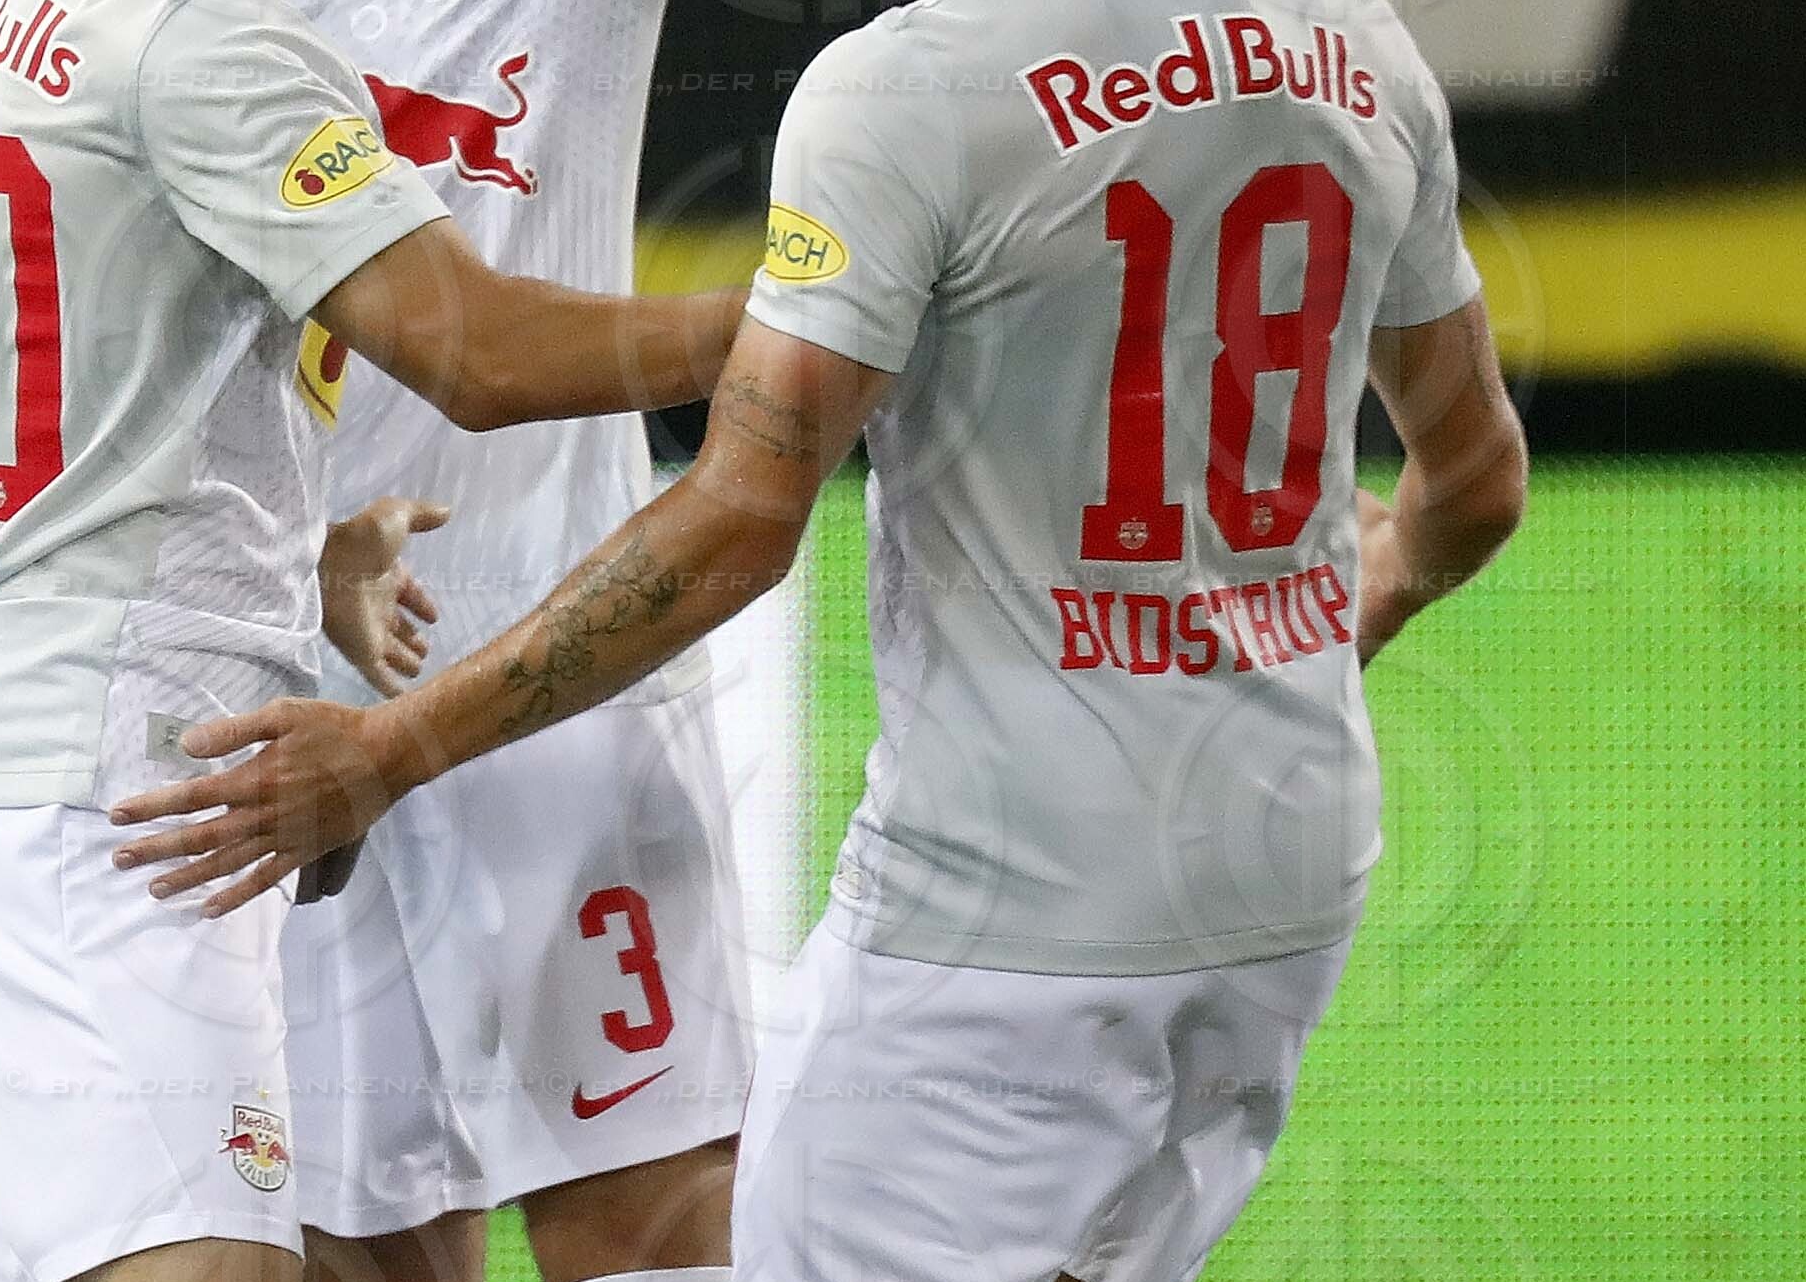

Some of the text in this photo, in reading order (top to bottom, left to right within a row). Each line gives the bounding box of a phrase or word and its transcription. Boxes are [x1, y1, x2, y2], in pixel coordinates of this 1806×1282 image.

[1025, 17, 1376, 151] Red Bulls
[1080, 163, 1354, 563] 18
[1050, 563, 1353, 676] BIDSTRUP
[578, 886, 674, 1053] 3
